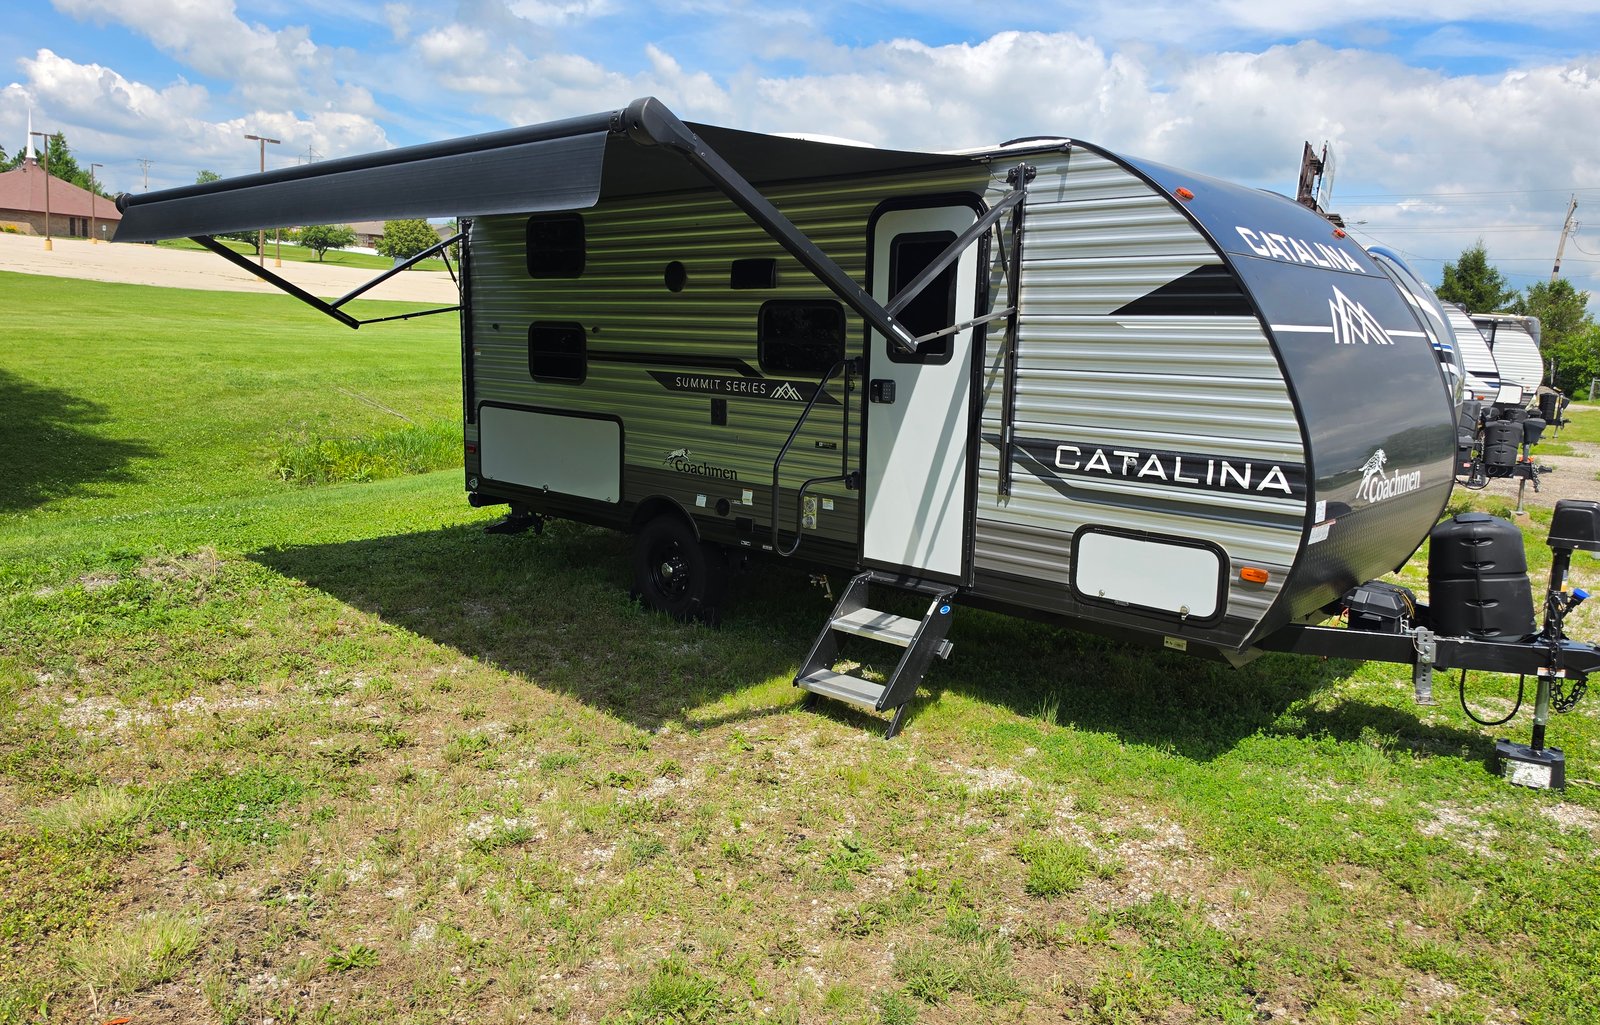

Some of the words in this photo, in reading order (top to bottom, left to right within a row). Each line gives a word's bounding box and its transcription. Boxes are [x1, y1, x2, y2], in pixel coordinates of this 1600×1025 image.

[1234, 225, 1366, 273] CATALINA
[675, 376, 721, 390] SUMMIT
[726, 380, 766, 394] SERIES
[674, 460, 737, 480] Coachmen
[1054, 444, 1293, 495] CATALINA
[1368, 469, 1421, 503] Coachmen
